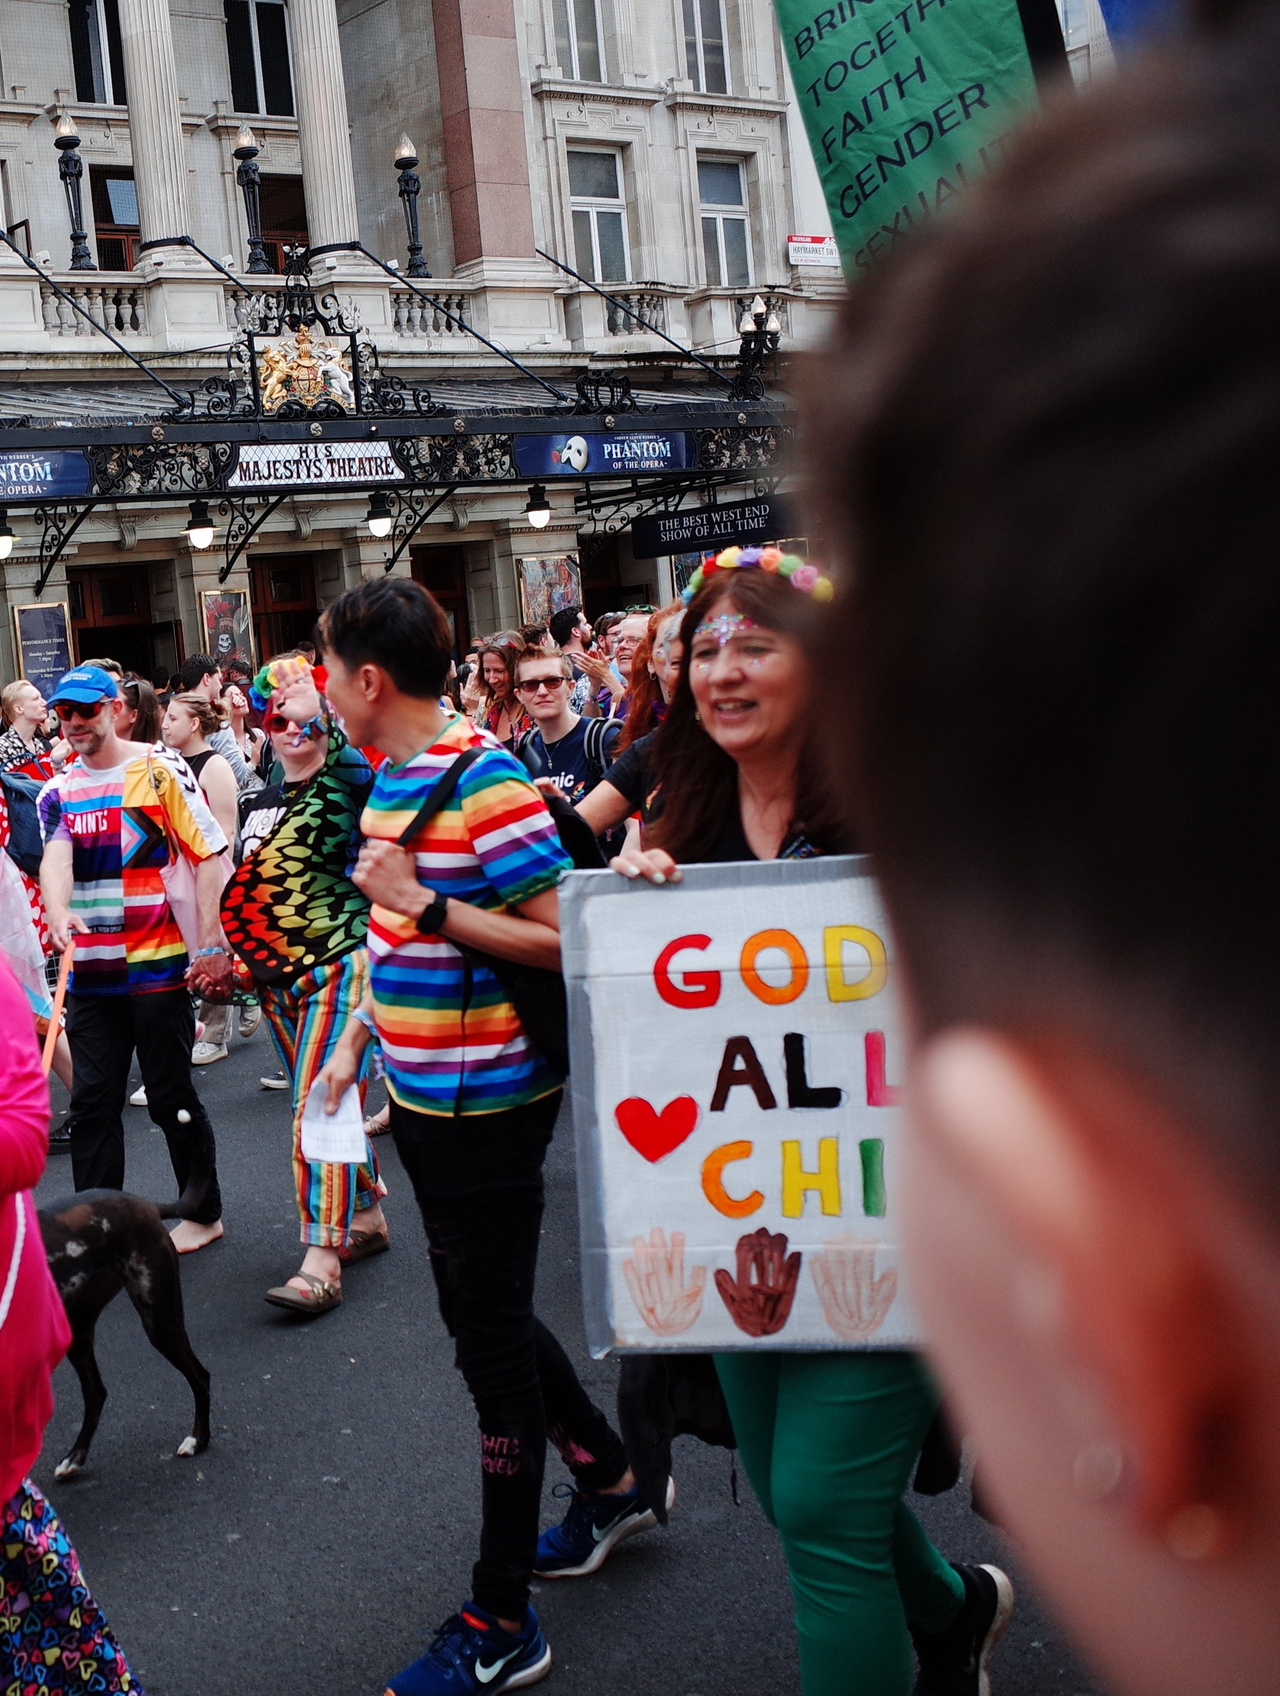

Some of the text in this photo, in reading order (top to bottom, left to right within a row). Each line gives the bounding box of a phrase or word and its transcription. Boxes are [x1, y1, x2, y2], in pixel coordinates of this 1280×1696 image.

[820, 55, 928, 165] FAITH
[839, 83, 990, 219] GENDER
[792, 245, 824, 255] HAYMARKET
[299, 445, 332, 459] HIS
[603, 440, 671, 459] PHANTOM
[327, 456, 394, 478] THEATRE
[612, 460, 664, 470] OF THE OPERA
[7, 485, 42, 495] OPERA
[658, 504, 770, 532] THE BEST WEST END
[660, 527, 693, 543] SHOW
[695, 526, 710, 538] OF
[713, 522, 734, 535] ALL
[67, 809, 108, 834] SAINTS
[652, 925, 888, 1009] GOD
[709, 1029, 904, 1113] ALL
[701, 1137, 887, 1219] CHI
